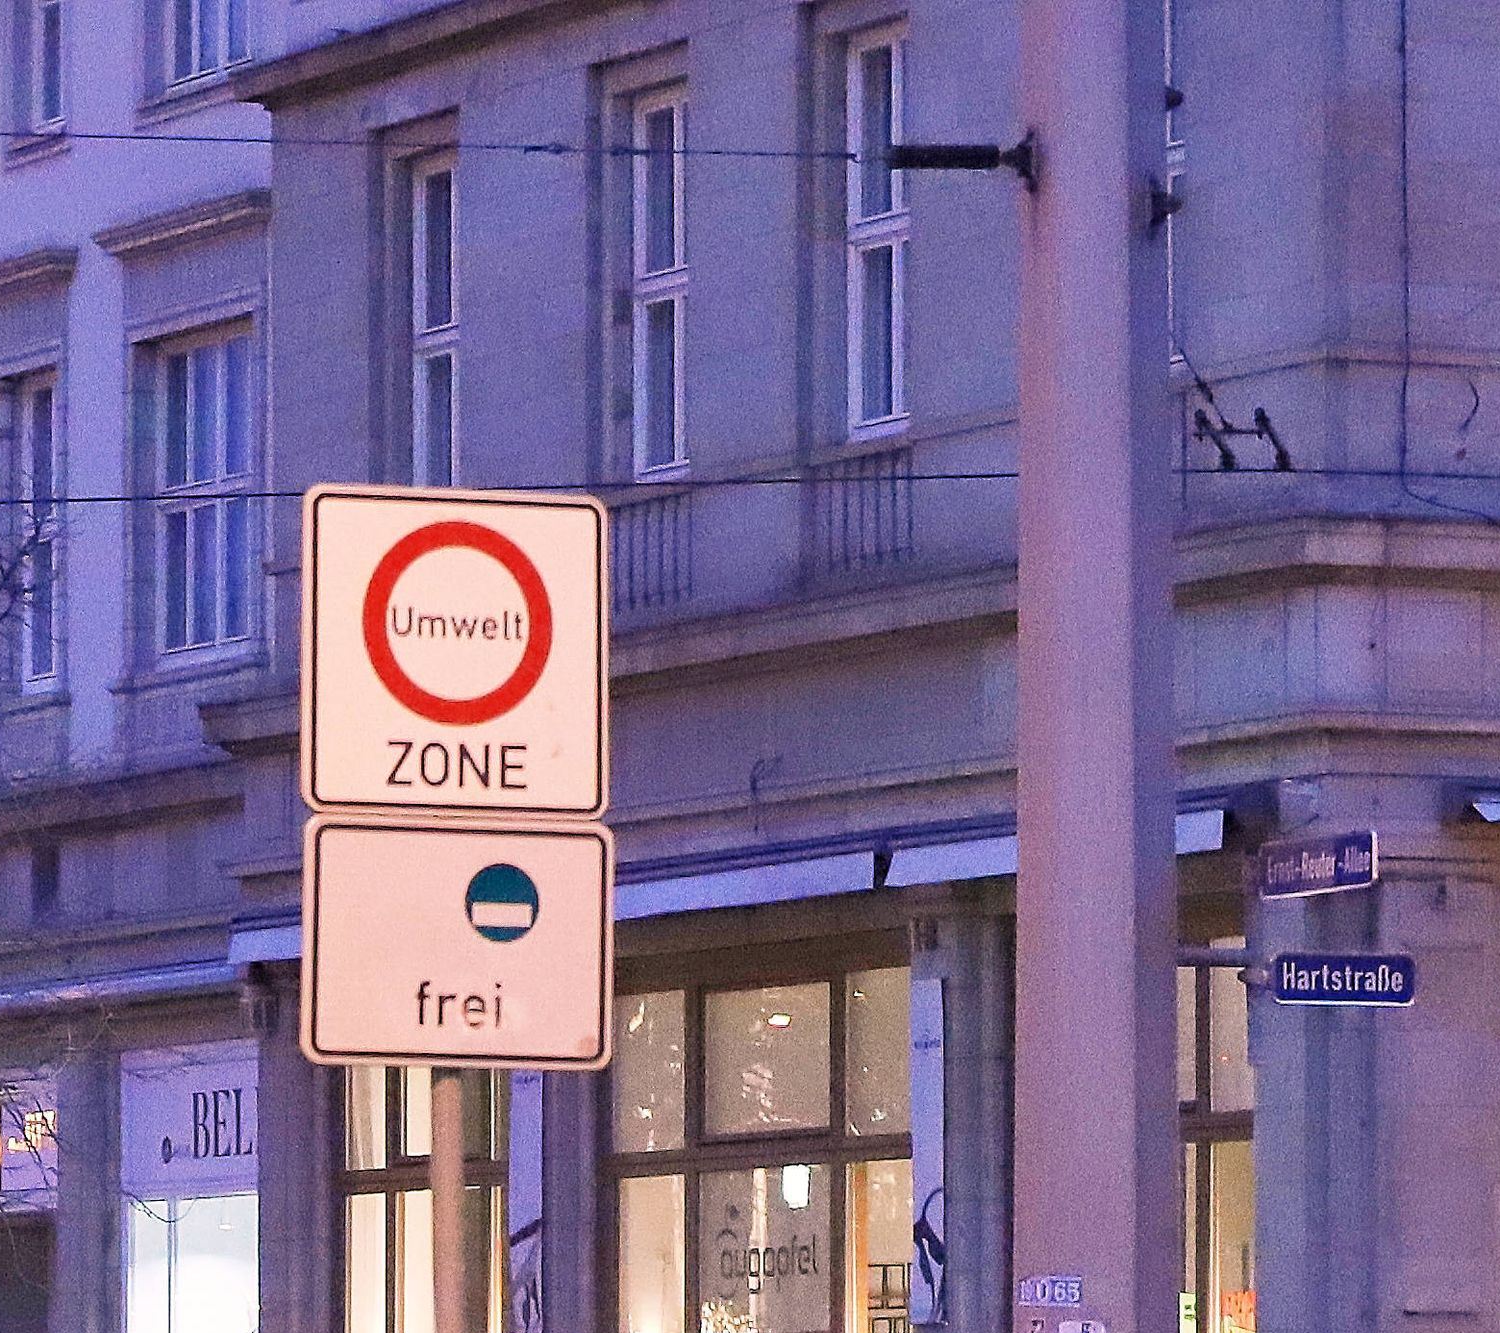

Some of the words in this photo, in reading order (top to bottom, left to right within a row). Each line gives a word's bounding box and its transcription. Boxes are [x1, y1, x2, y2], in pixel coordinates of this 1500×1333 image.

[390, 606, 524, 643] Umwelt
[387, 740, 529, 790] ZONE
[1282, 960, 1404, 993] Hartstraße
[416, 980, 503, 1028] frei
